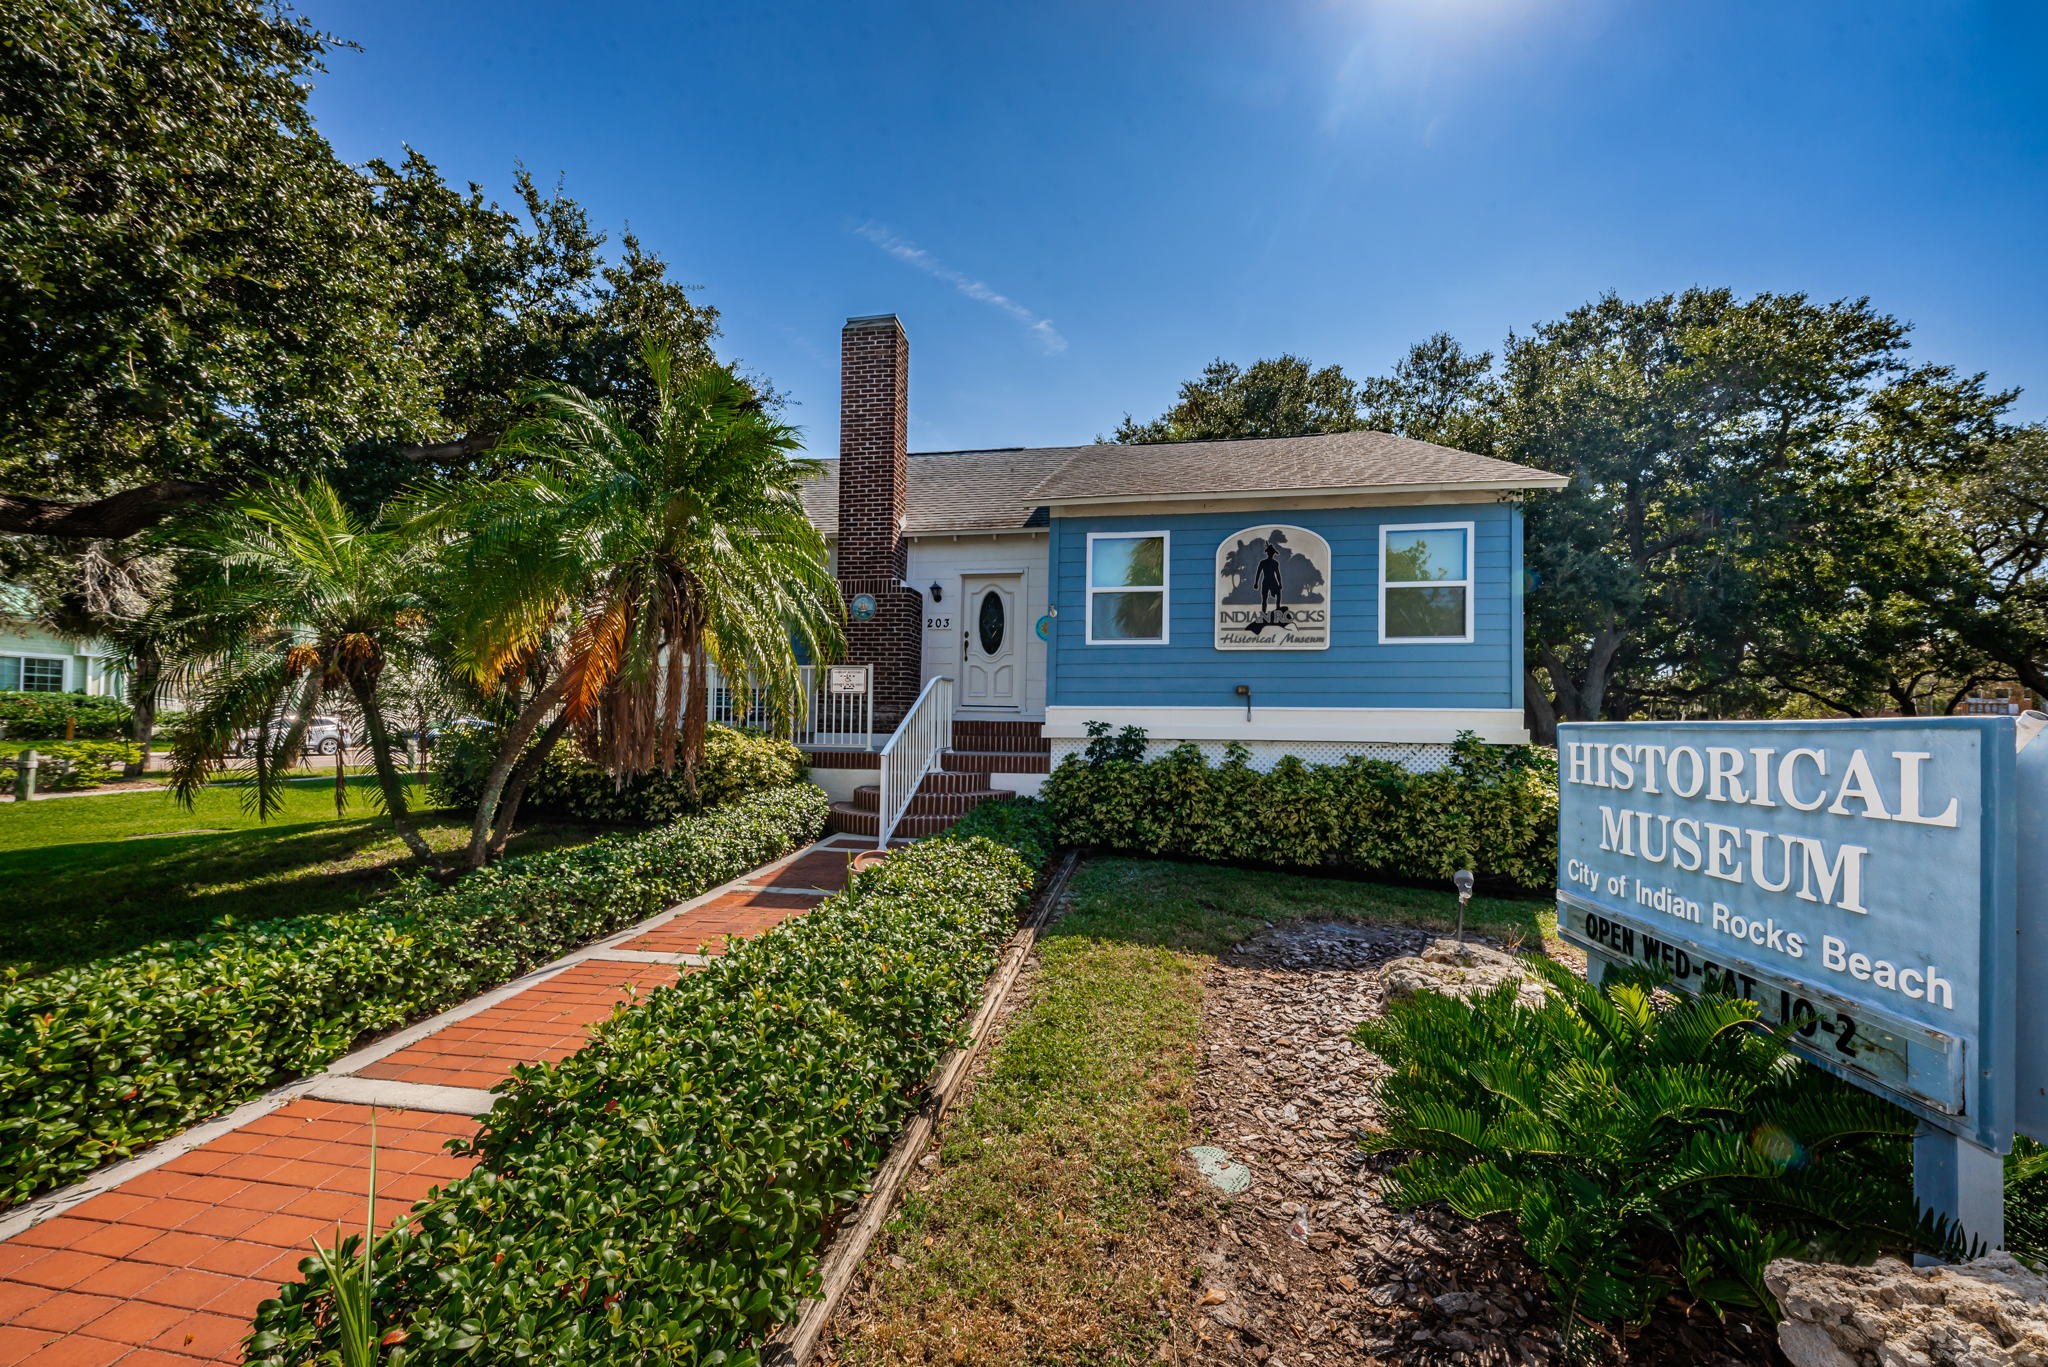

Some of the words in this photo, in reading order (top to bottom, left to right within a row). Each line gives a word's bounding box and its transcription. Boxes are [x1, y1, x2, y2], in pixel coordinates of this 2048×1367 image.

[927, 618, 950, 628] 203
[1220, 610, 1271, 624] INDIAN
[1273, 609, 1325, 623] ROCKS
[1220, 633, 1276, 644] Historical
[1279, 632, 1325, 646] Museum
[1567, 741, 1959, 828] HISTORICAL
[1599, 806, 1868, 915] MUSEUM
[1567, 858, 1600, 893] City
[1607, 876, 1627, 899] of
[1635, 879, 1701, 925] Indian
[1713, 902, 1804, 959] Rocks
[1822, 934, 1954, 1010] Beach
[1585, 913, 1635, 957] OPEN
